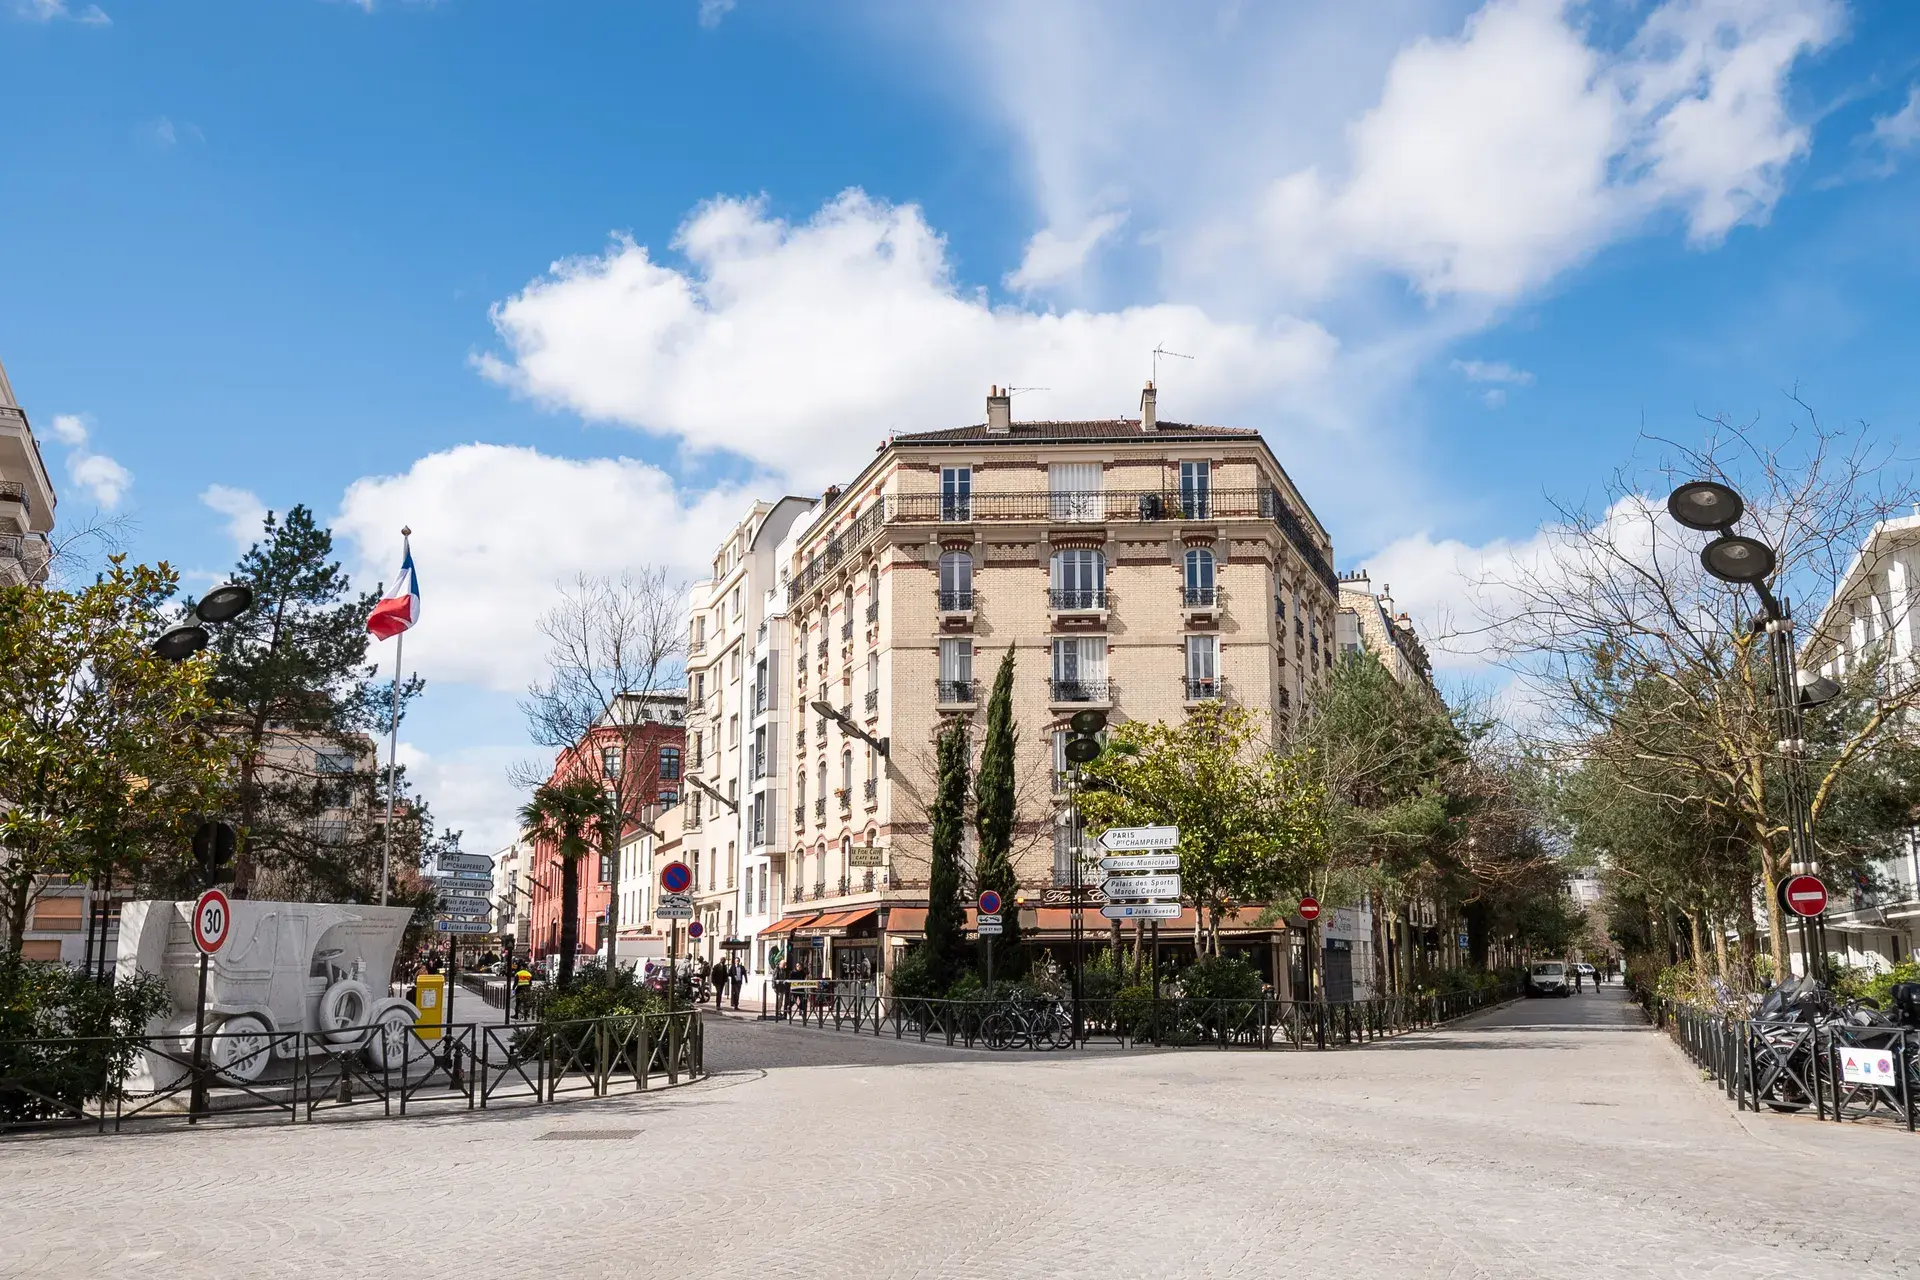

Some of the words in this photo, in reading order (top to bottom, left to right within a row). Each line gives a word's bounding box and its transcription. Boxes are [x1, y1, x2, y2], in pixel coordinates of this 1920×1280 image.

[1136, 859, 1176, 868] Municipale
[1151, 879, 1174, 887] Sports
[204, 908, 221, 934] 30
